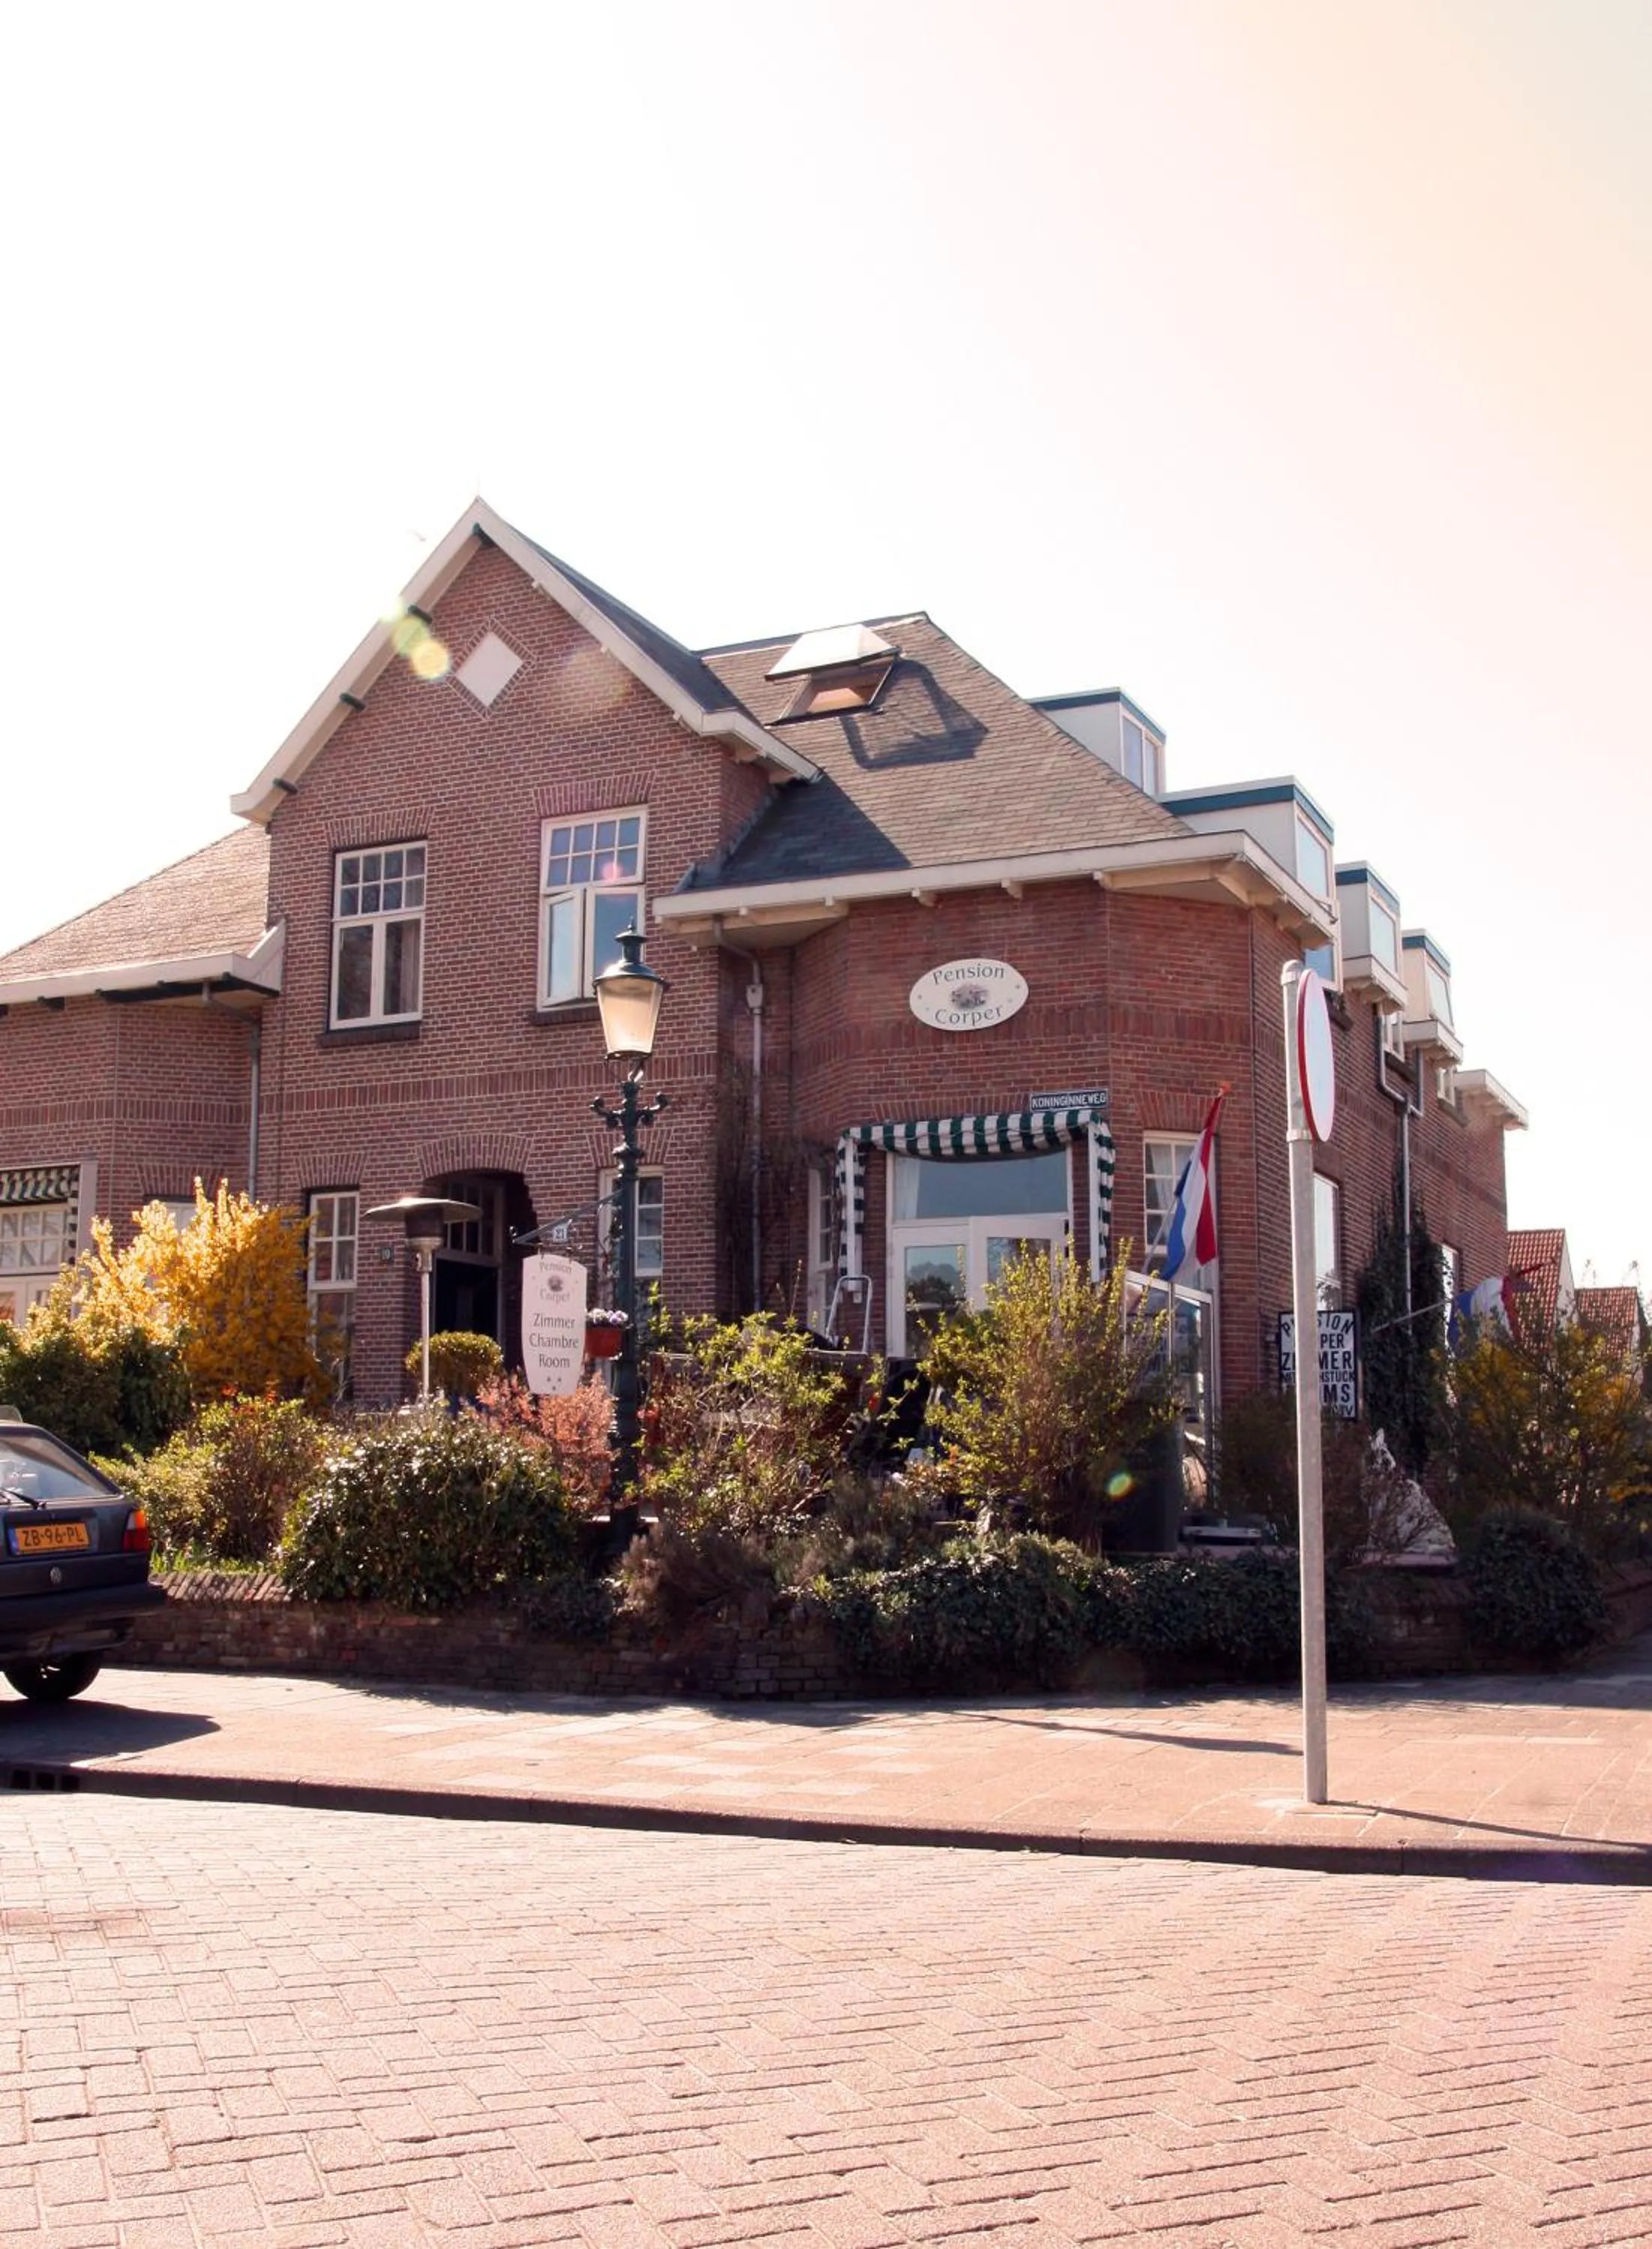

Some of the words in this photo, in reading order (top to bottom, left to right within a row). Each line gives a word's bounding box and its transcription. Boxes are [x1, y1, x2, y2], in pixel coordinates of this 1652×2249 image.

[933, 963, 1004, 985] Pension
[935, 1005, 1002, 1026] Corper
[1032, 1093, 1106, 1108] KONINGINNEWEG
[533, 1313, 575, 1329] Zimmer
[529, 1332, 579, 1349] Chambre
[539, 1354, 570, 1368] Room
[22, 1526, 84, 1547] ZB-96-PL
